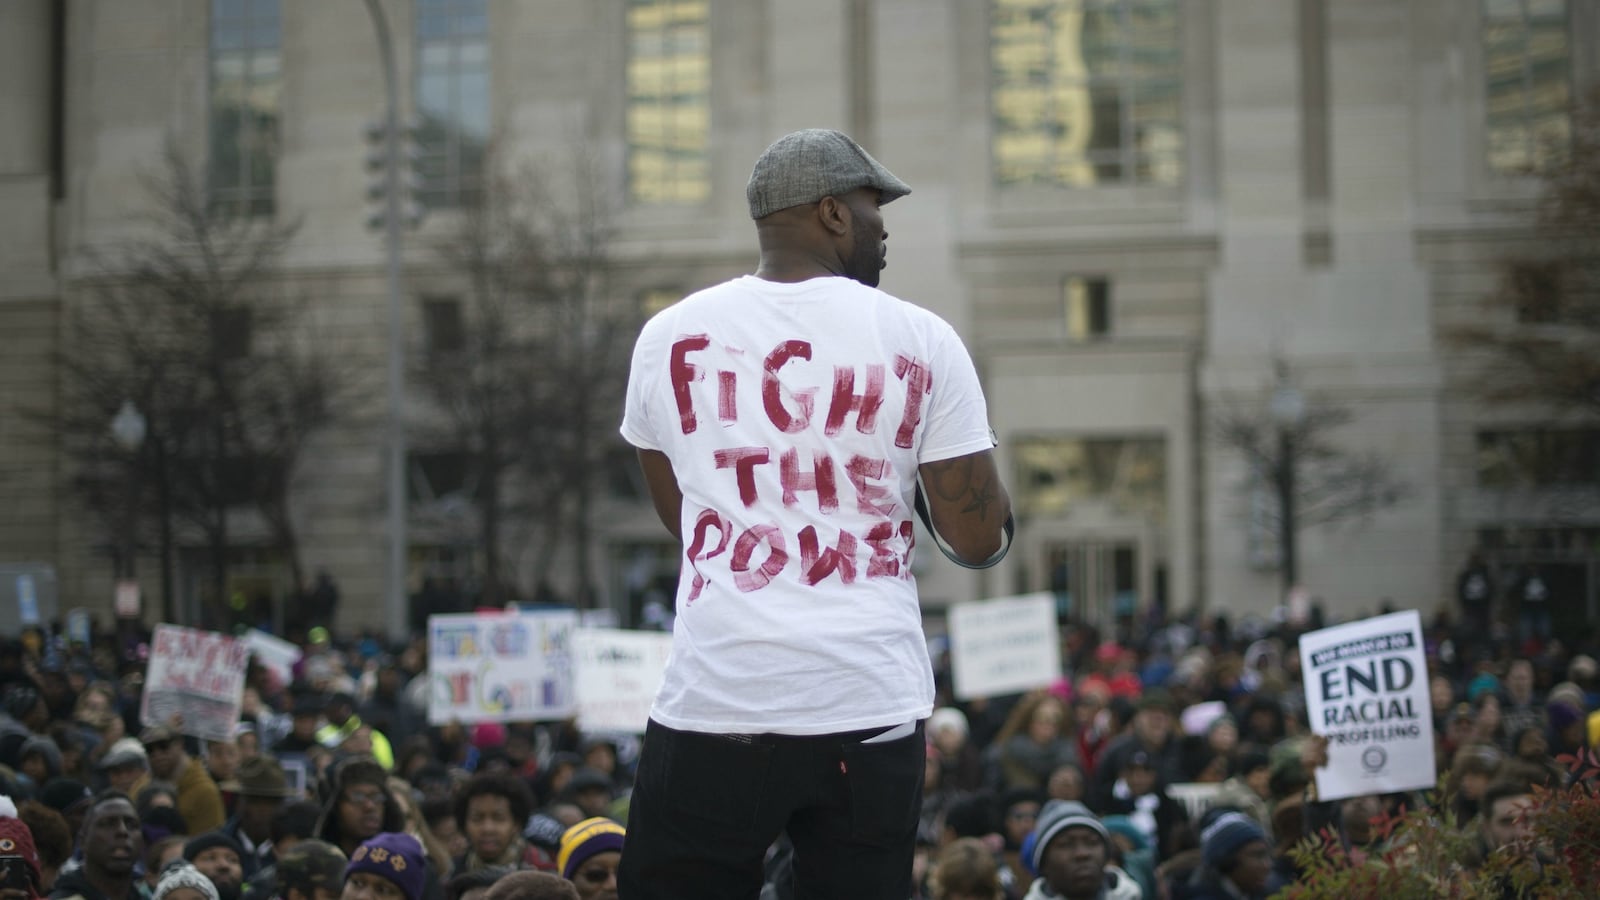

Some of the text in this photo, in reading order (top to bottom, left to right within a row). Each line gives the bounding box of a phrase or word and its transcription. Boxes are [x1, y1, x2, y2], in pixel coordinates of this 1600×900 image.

[713, 446, 897, 516] THE
[1320, 657, 1415, 701] END
[1322, 698, 1419, 728] RACIAL
